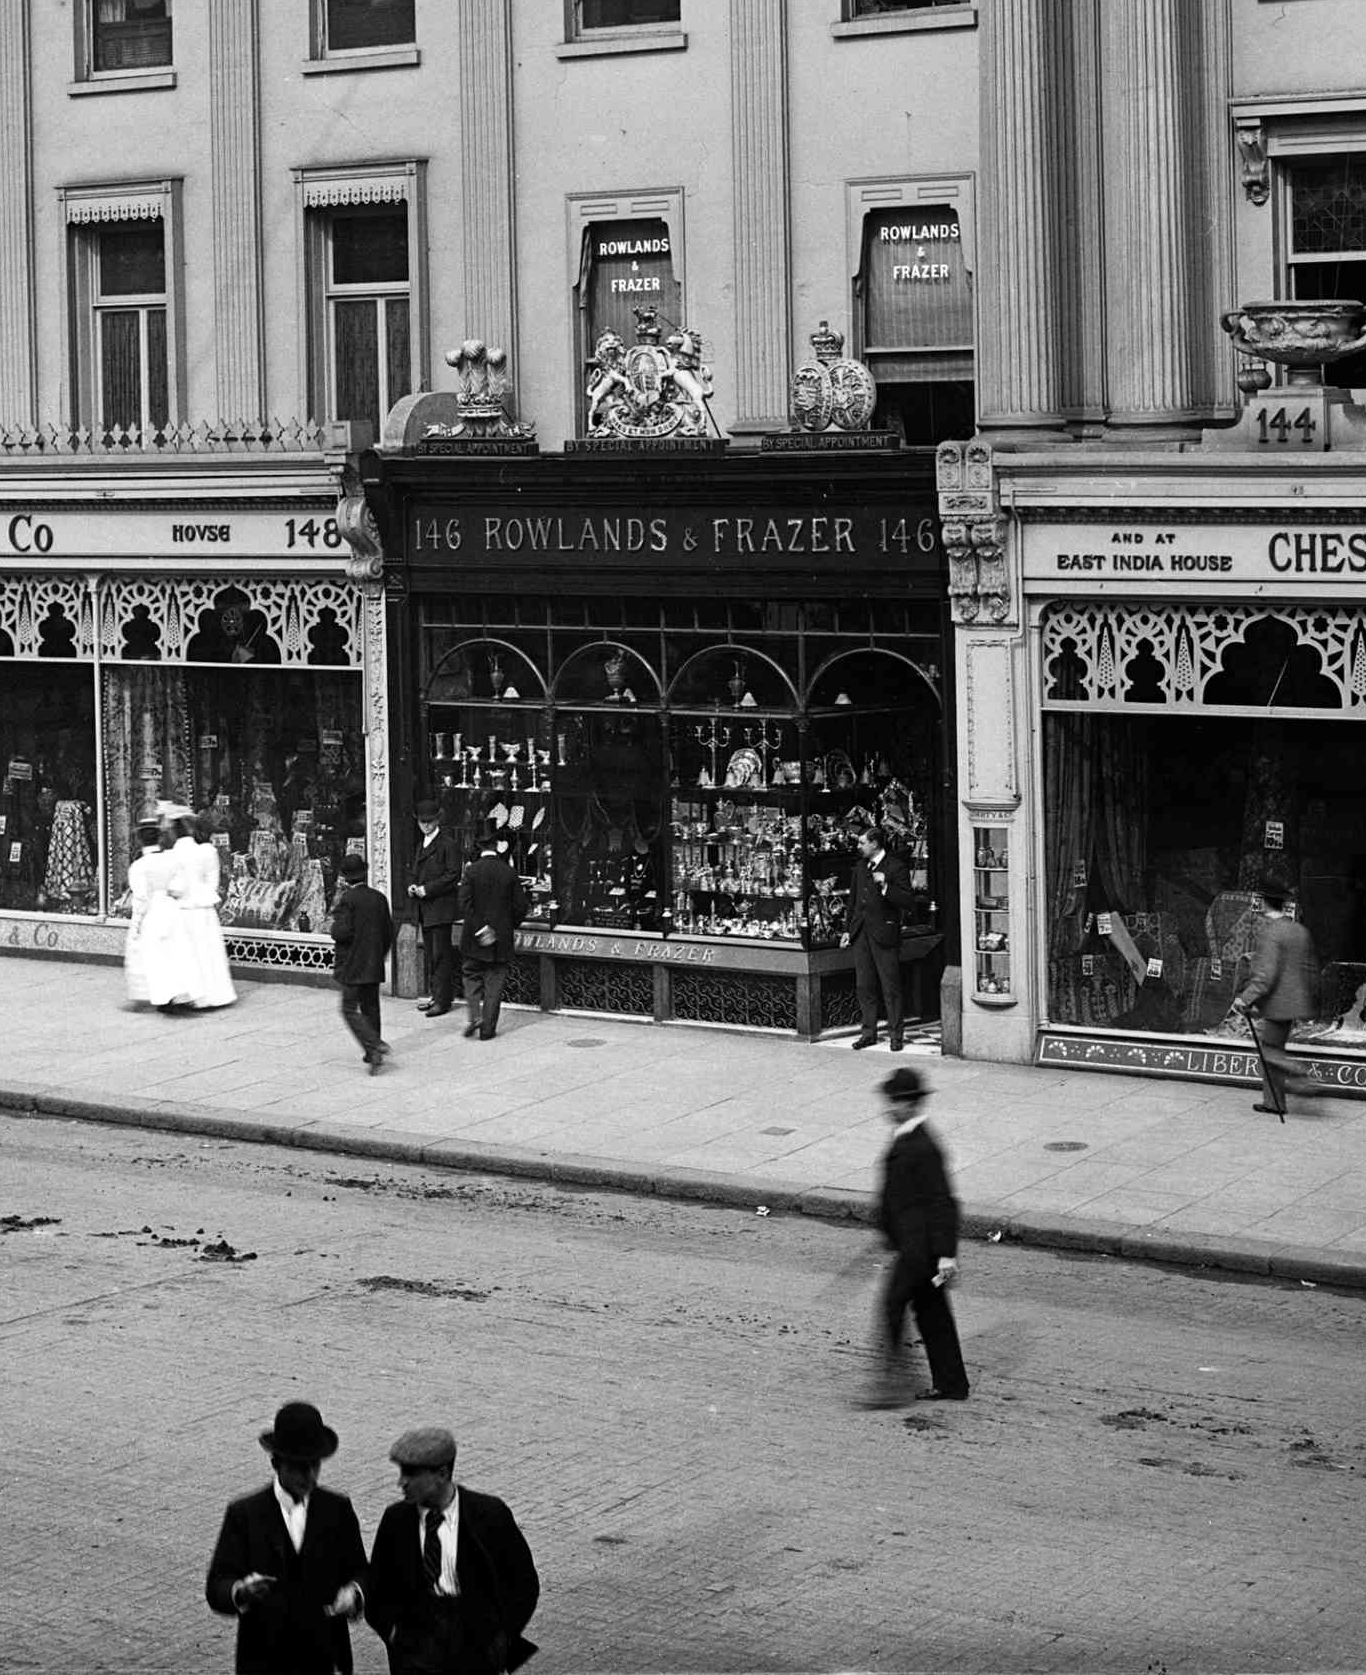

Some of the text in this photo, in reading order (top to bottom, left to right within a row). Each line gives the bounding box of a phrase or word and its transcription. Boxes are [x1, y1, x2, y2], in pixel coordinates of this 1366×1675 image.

[880, 223, 959, 241] ROWLANDS
[599, 237, 669, 256] ROWLANDS
[917, 246, 925, 257] &
[631, 261, 639, 271] &
[892, 264, 949, 279] FRAZER
[611, 277, 660, 292] FRAZER
[1256, 406, 1317, 443] 144
[429, 443, 465, 454] SPECIAL
[466, 443, 529, 454] APPOINTMENT
[566, 440, 714, 453] BY SPECIAL APPOINTMENT
[762, 435, 889, 450] BY SPECIAL APPOINTMENT
[284, 518, 343, 549] 148
[414, 517, 935, 553] 146 ROWLANDS & FRAZER 146
[1111, 533, 1176, 545] AND AT
[1056, 554, 1233, 572] EAST INDIA HOUSE
[9, 924, 21, 945] &
[610, 941, 621, 956] &
[634, 939, 716, 963] FRAZER
[1186, 1050, 1261, 1077] LIBER
